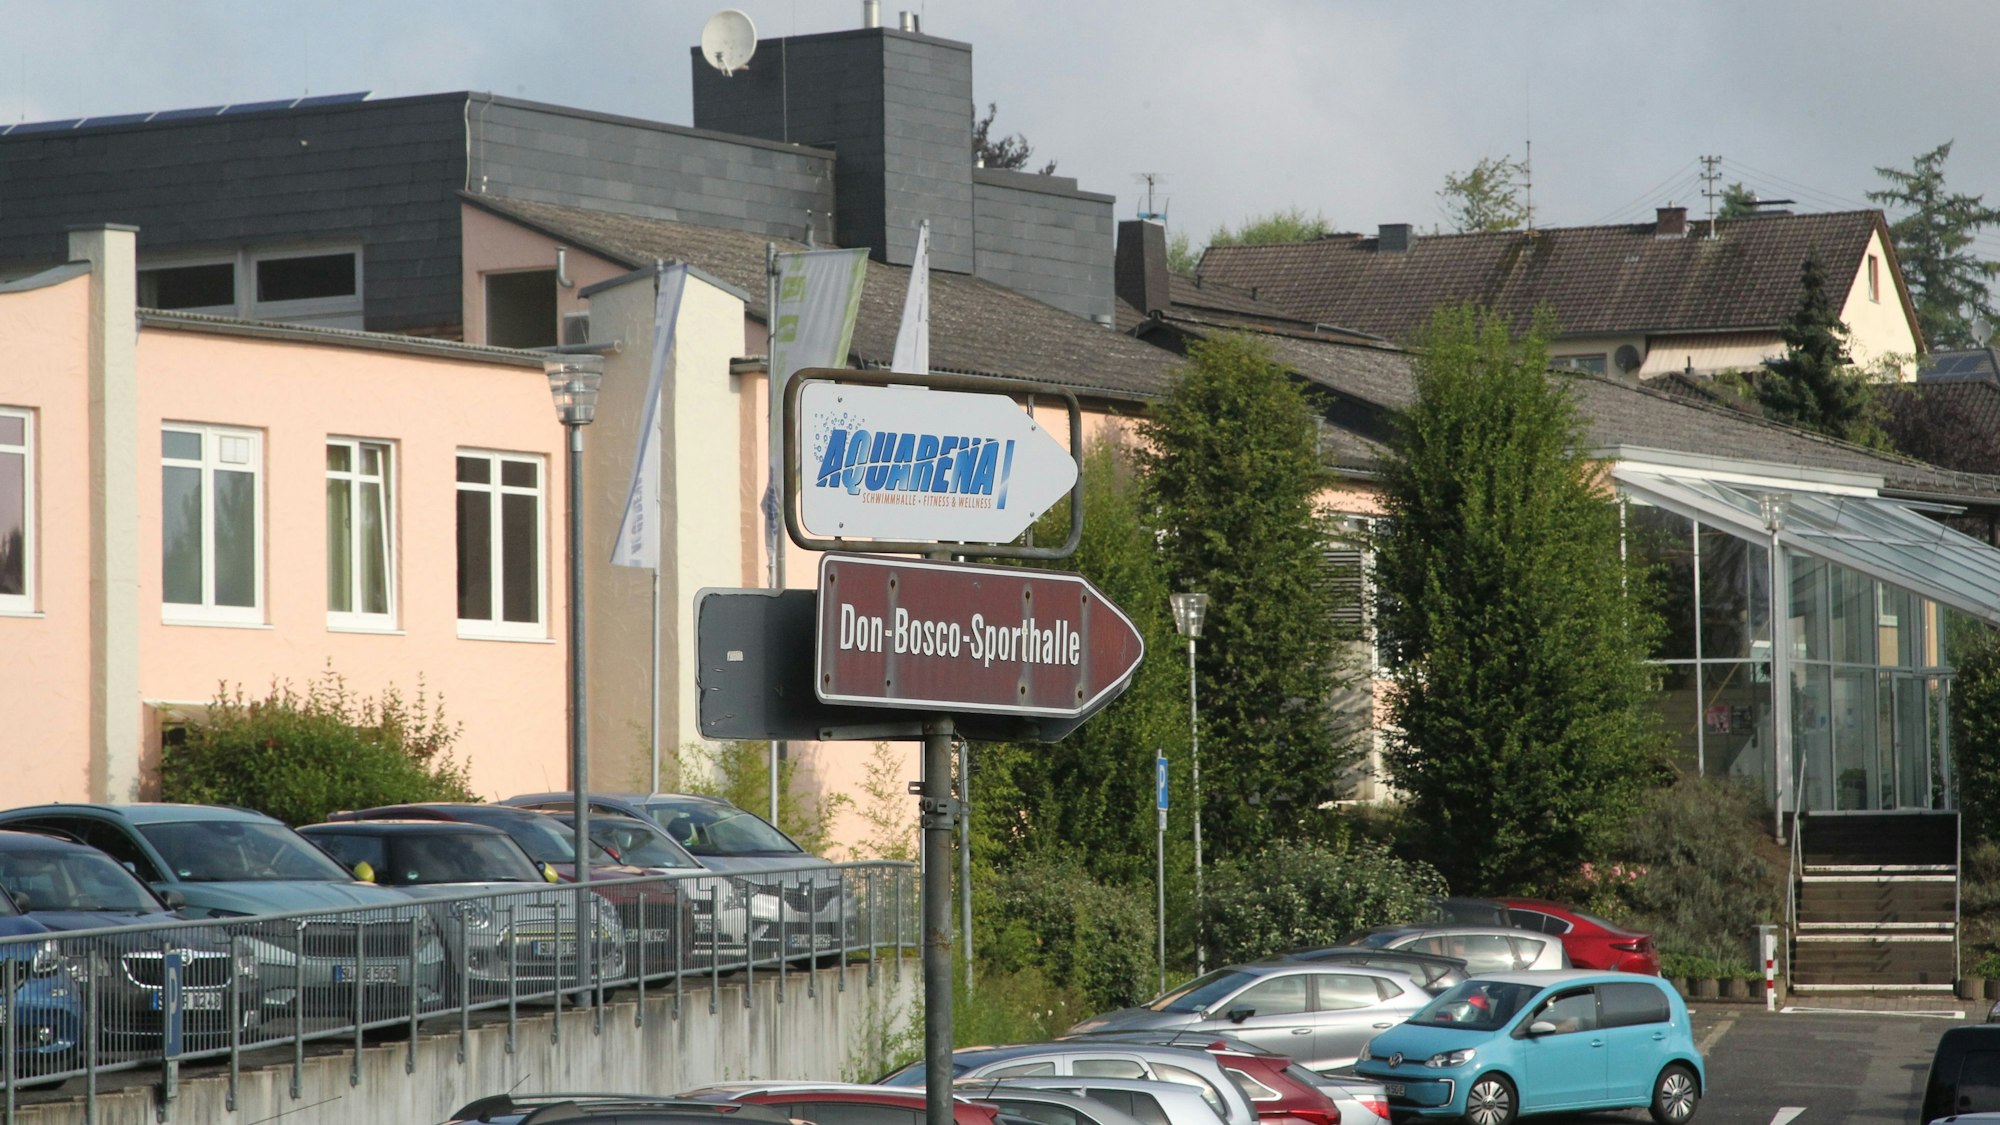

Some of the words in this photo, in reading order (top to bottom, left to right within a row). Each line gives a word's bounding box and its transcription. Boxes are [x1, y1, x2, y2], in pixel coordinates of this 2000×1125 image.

[862, 492, 917, 506] SCHWIMMHALLE
[923, 495, 949, 508] FITNESS
[951, 496, 956, 508] &
[958, 497, 992, 509] WELLNESS
[840, 603, 1080, 668] Don-Bosco-Sporthalle
[1159, 765, 1165, 802] P
[169, 967, 178, 1044] P
